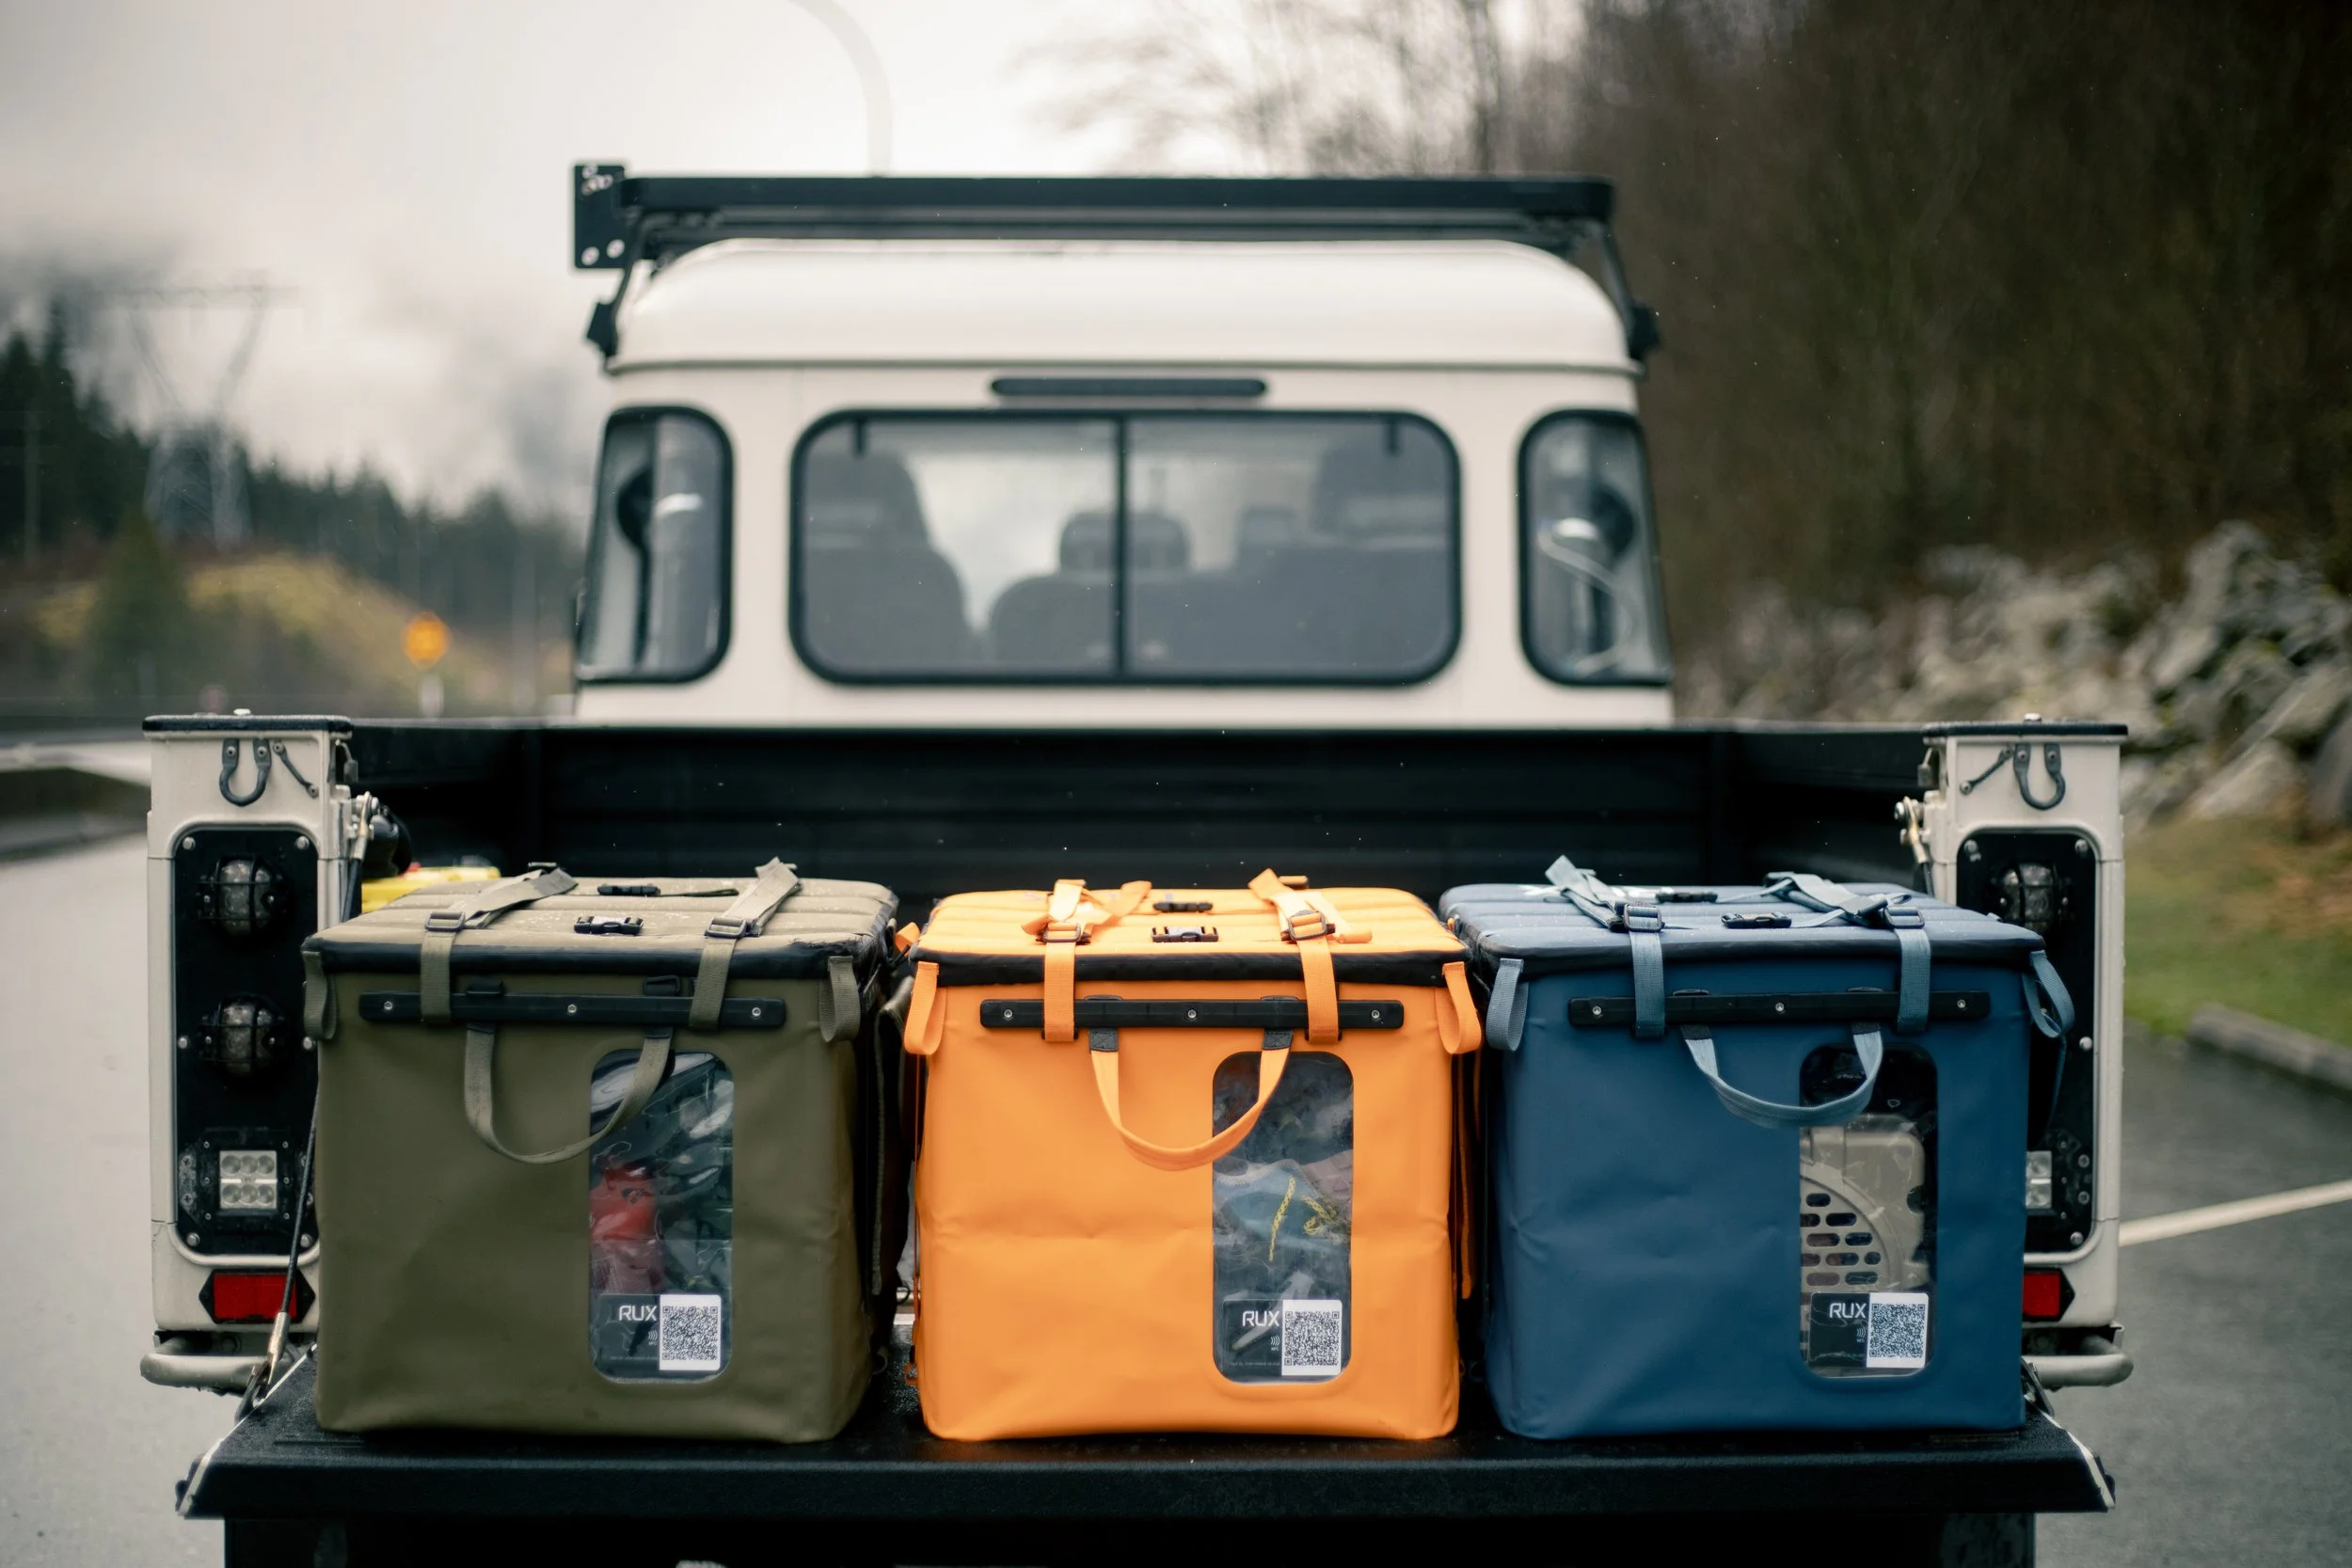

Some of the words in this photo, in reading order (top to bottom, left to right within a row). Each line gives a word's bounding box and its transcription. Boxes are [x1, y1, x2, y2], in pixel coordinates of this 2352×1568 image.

[619, 1305, 657, 1321] RUX
[1242, 1310, 1279, 1326] RUX
[1829, 1303, 1867, 1318] RUX
